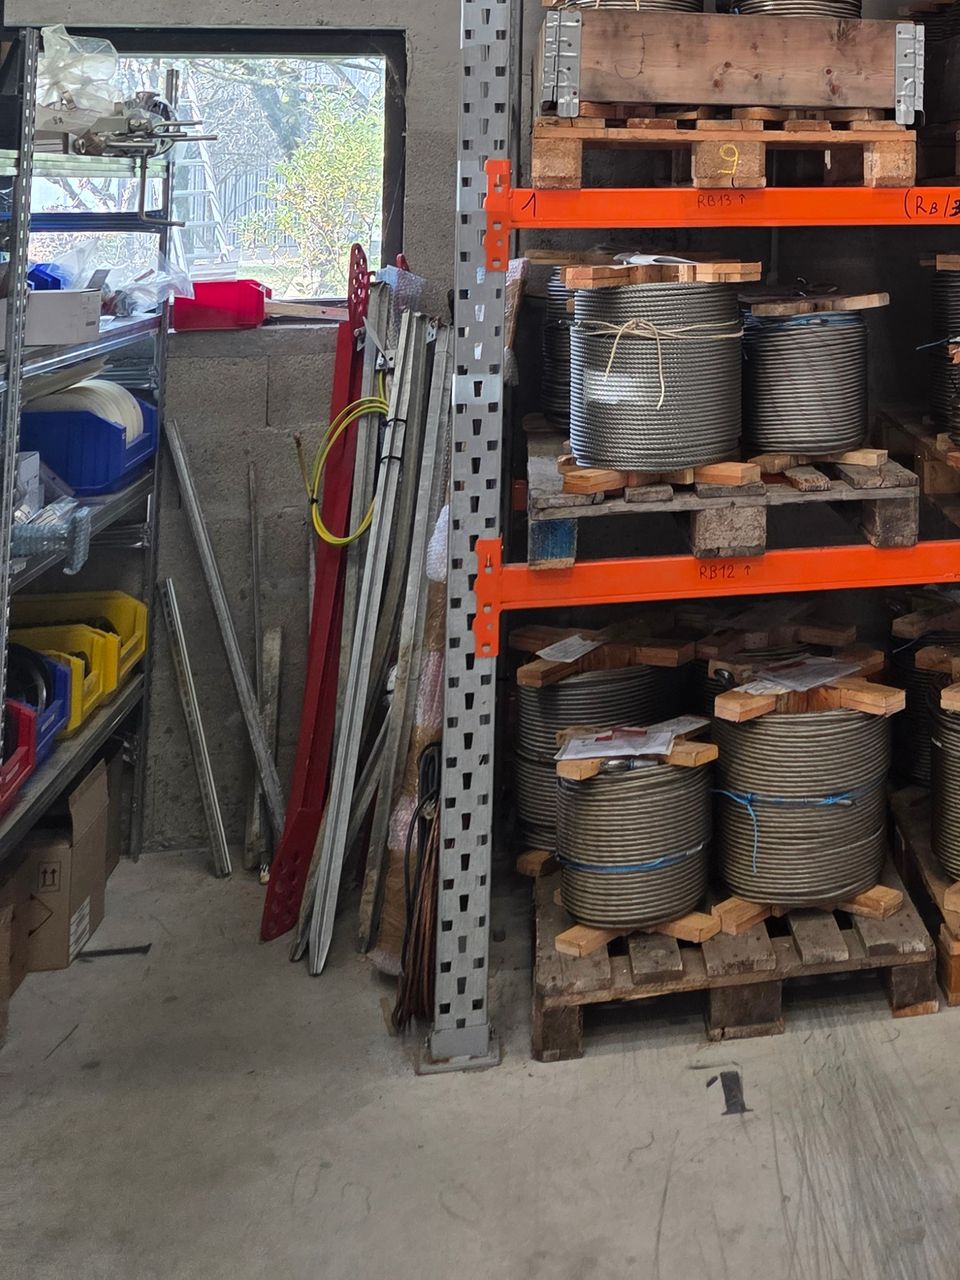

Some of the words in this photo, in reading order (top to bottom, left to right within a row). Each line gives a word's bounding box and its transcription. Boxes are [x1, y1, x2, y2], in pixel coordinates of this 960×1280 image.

[520, 191, 538, 218] 1
[697, 194, 734, 209] RB13
[698, 563, 736, 580] RB12
[705, 1069, 755, 1116] 1
